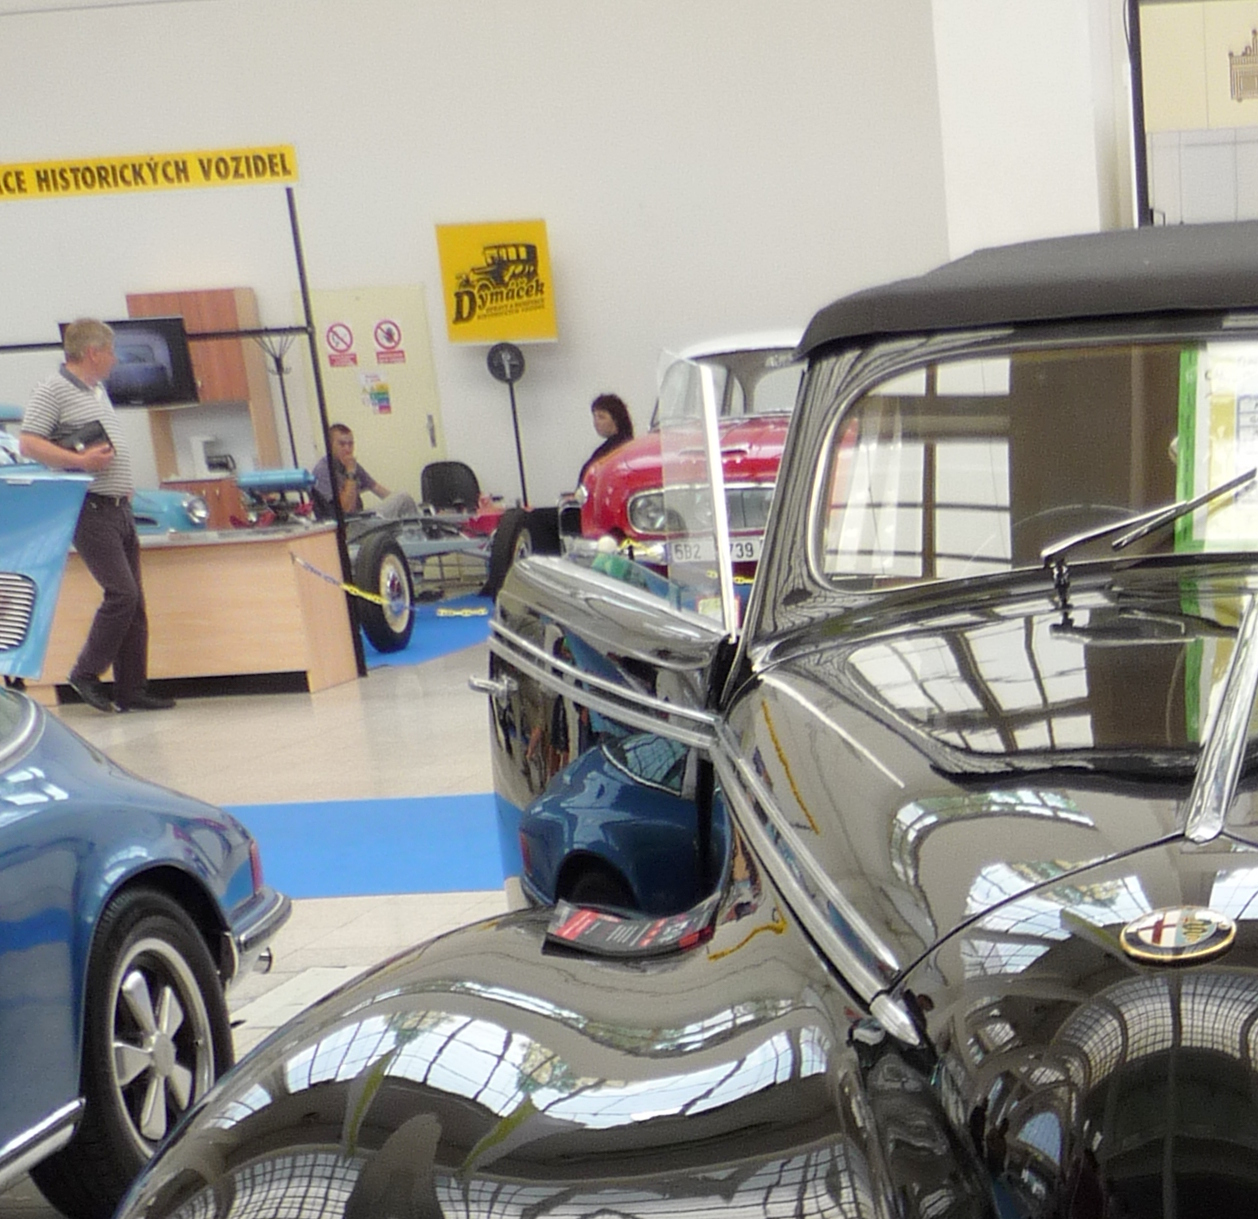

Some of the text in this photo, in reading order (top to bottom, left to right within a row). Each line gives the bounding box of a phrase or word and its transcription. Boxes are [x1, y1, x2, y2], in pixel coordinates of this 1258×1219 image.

[0, 152, 292, 195] CE HISTORICKÝCH VOZIDEL
